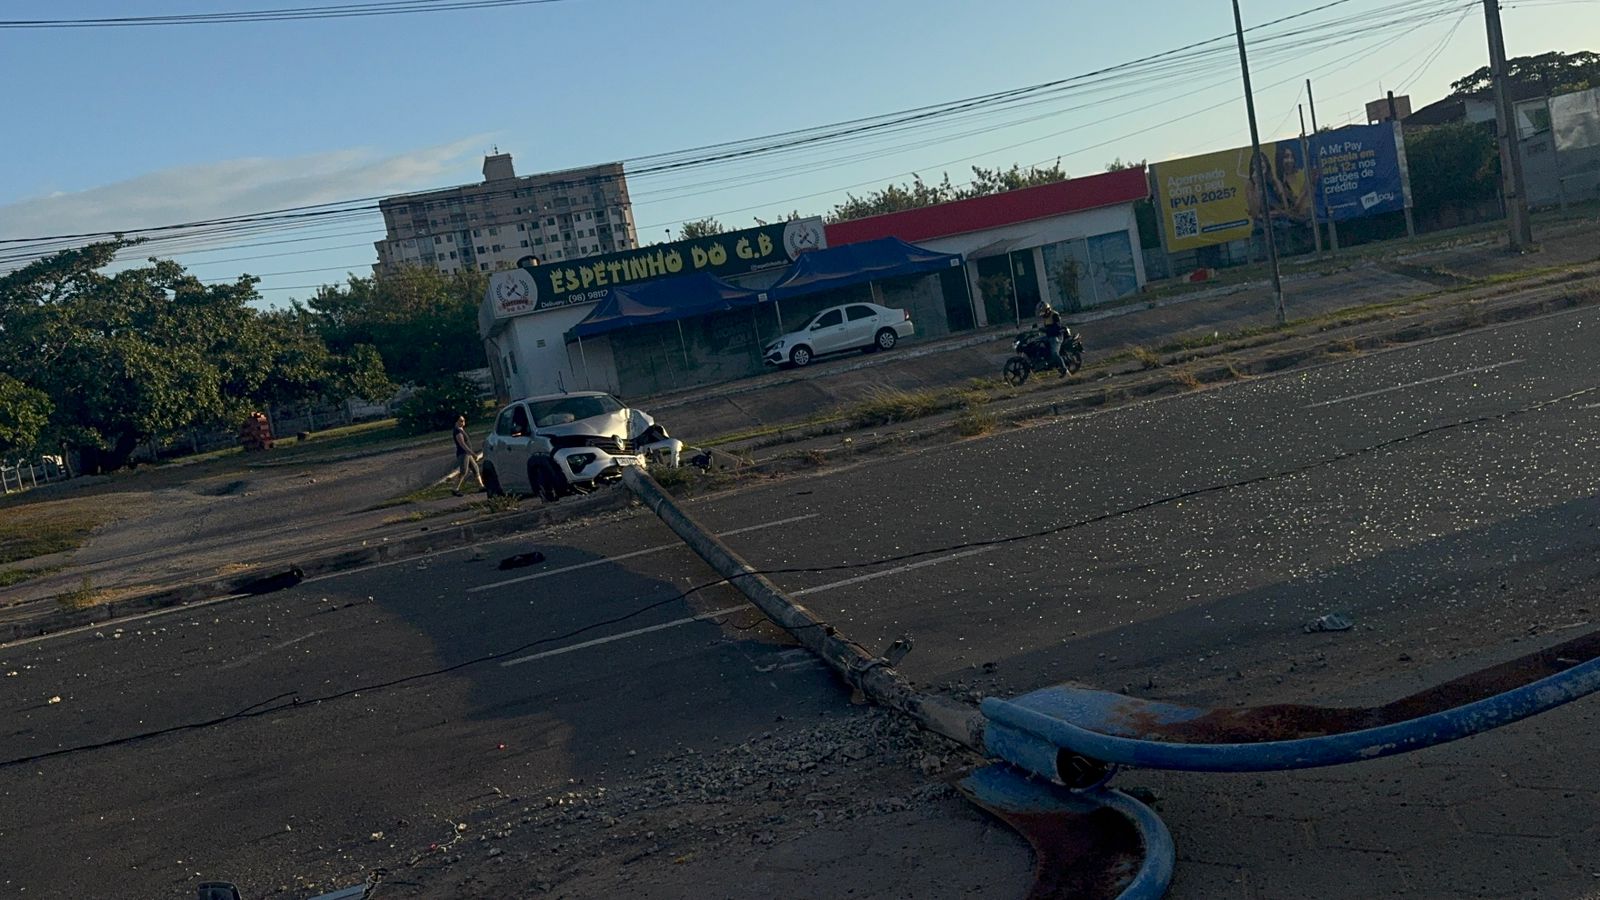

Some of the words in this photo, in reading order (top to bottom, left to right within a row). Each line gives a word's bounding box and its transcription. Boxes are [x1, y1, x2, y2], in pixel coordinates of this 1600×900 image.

[1320, 146, 1327, 155] A
[1328, 144, 1342, 154] Mr
[1344, 142, 1362, 152] Pay
[1359, 159, 1376, 168] nos
[1324, 171, 1359, 184] cartões
[1361, 168, 1374, 178] de
[1169, 185, 1192, 197] com
[1325, 181, 1358, 194] crédito
[1170, 194, 1198, 208] IPVA
[1201, 187, 1236, 202] 2025?
[550, 249, 682, 294] ESPETINHO
[691, 242, 727, 268] DO
[736, 232, 773, 260] G.B
[568, 292, 586, 304] (98)
